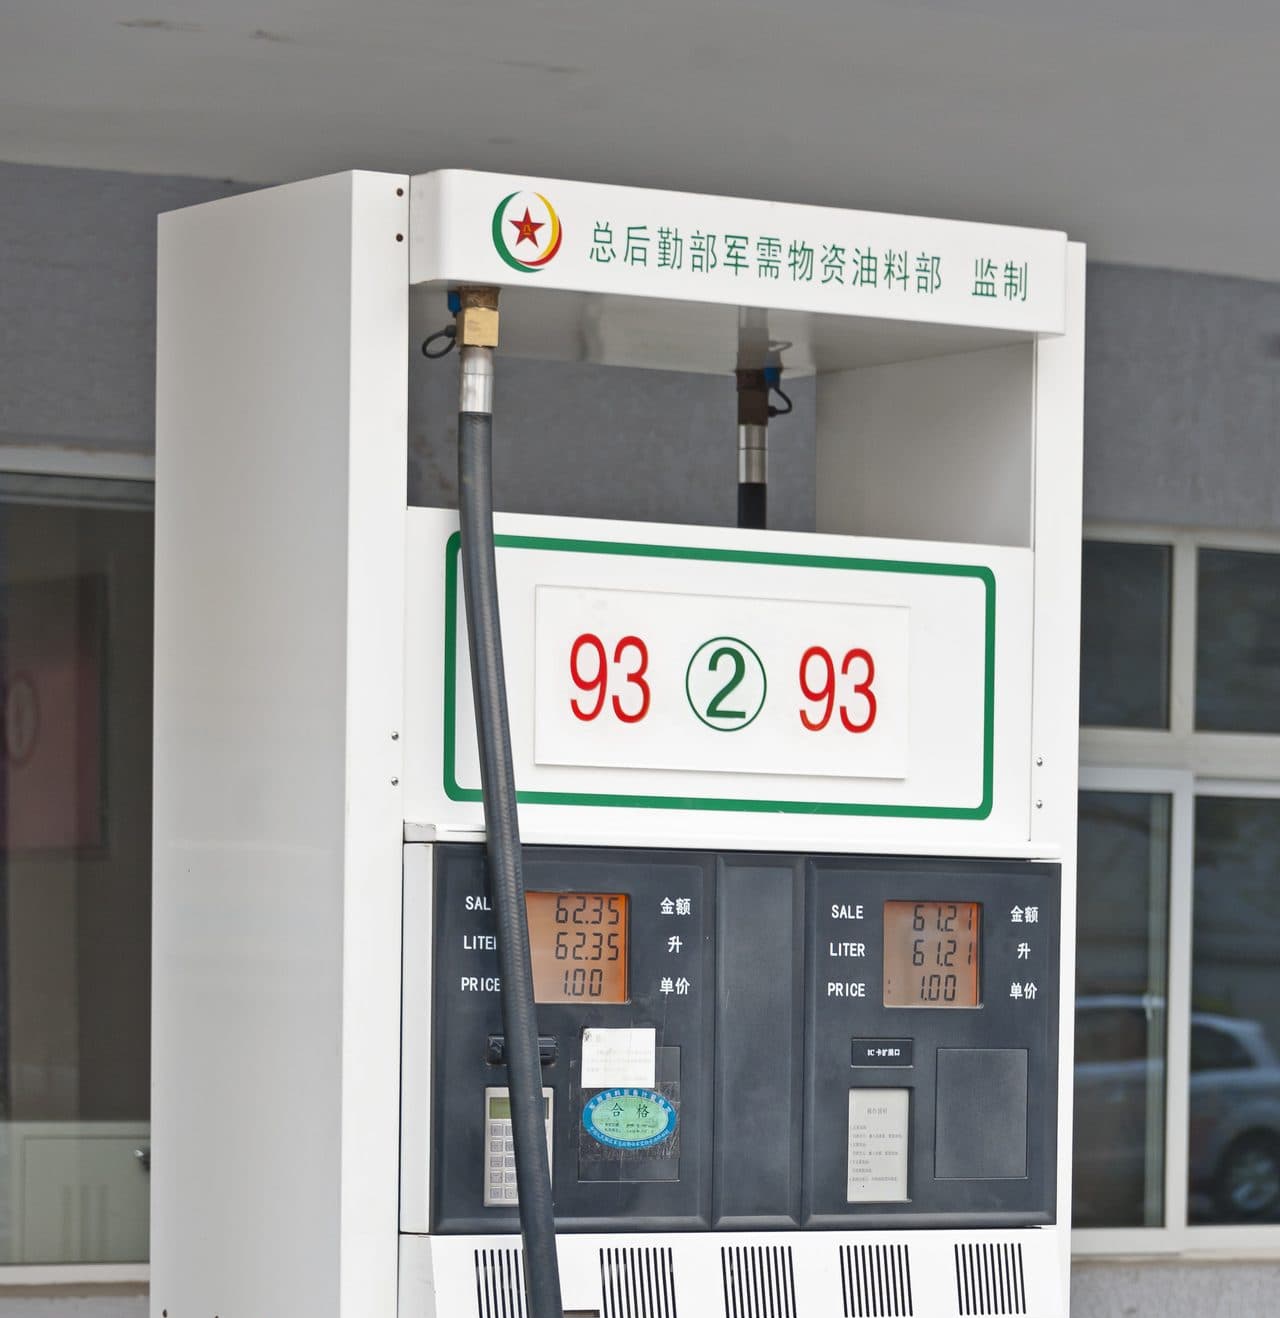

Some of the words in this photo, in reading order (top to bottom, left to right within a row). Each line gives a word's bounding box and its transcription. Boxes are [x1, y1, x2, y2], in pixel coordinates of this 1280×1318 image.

[589, 220, 943, 295] 总后勤部军需物资油料部
[971, 257, 1029, 303] 监制
[570, 633, 651, 724] 93
[799, 645, 878, 734] 93
[465, 895, 492, 911] SAL
[555, 895, 619, 925] 62.35
[660, 896, 691, 916] 金额
[831, 904, 864, 920] SALE
[1010, 905, 1039, 924] 金额
[555, 931, 619, 961] 62.35
[667, 935, 683, 954] 升
[829, 942, 866, 957] LITER
[1017, 942, 1031, 960] 升
[461, 976, 501, 992] PRICE
[563, 968, 603, 996] 1.00
[659, 976, 691, 995] 单价
[827, 982, 866, 998] PRICE
[919, 974, 957, 1001] 1.00
[1009, 982, 1038, 1000] 单价
